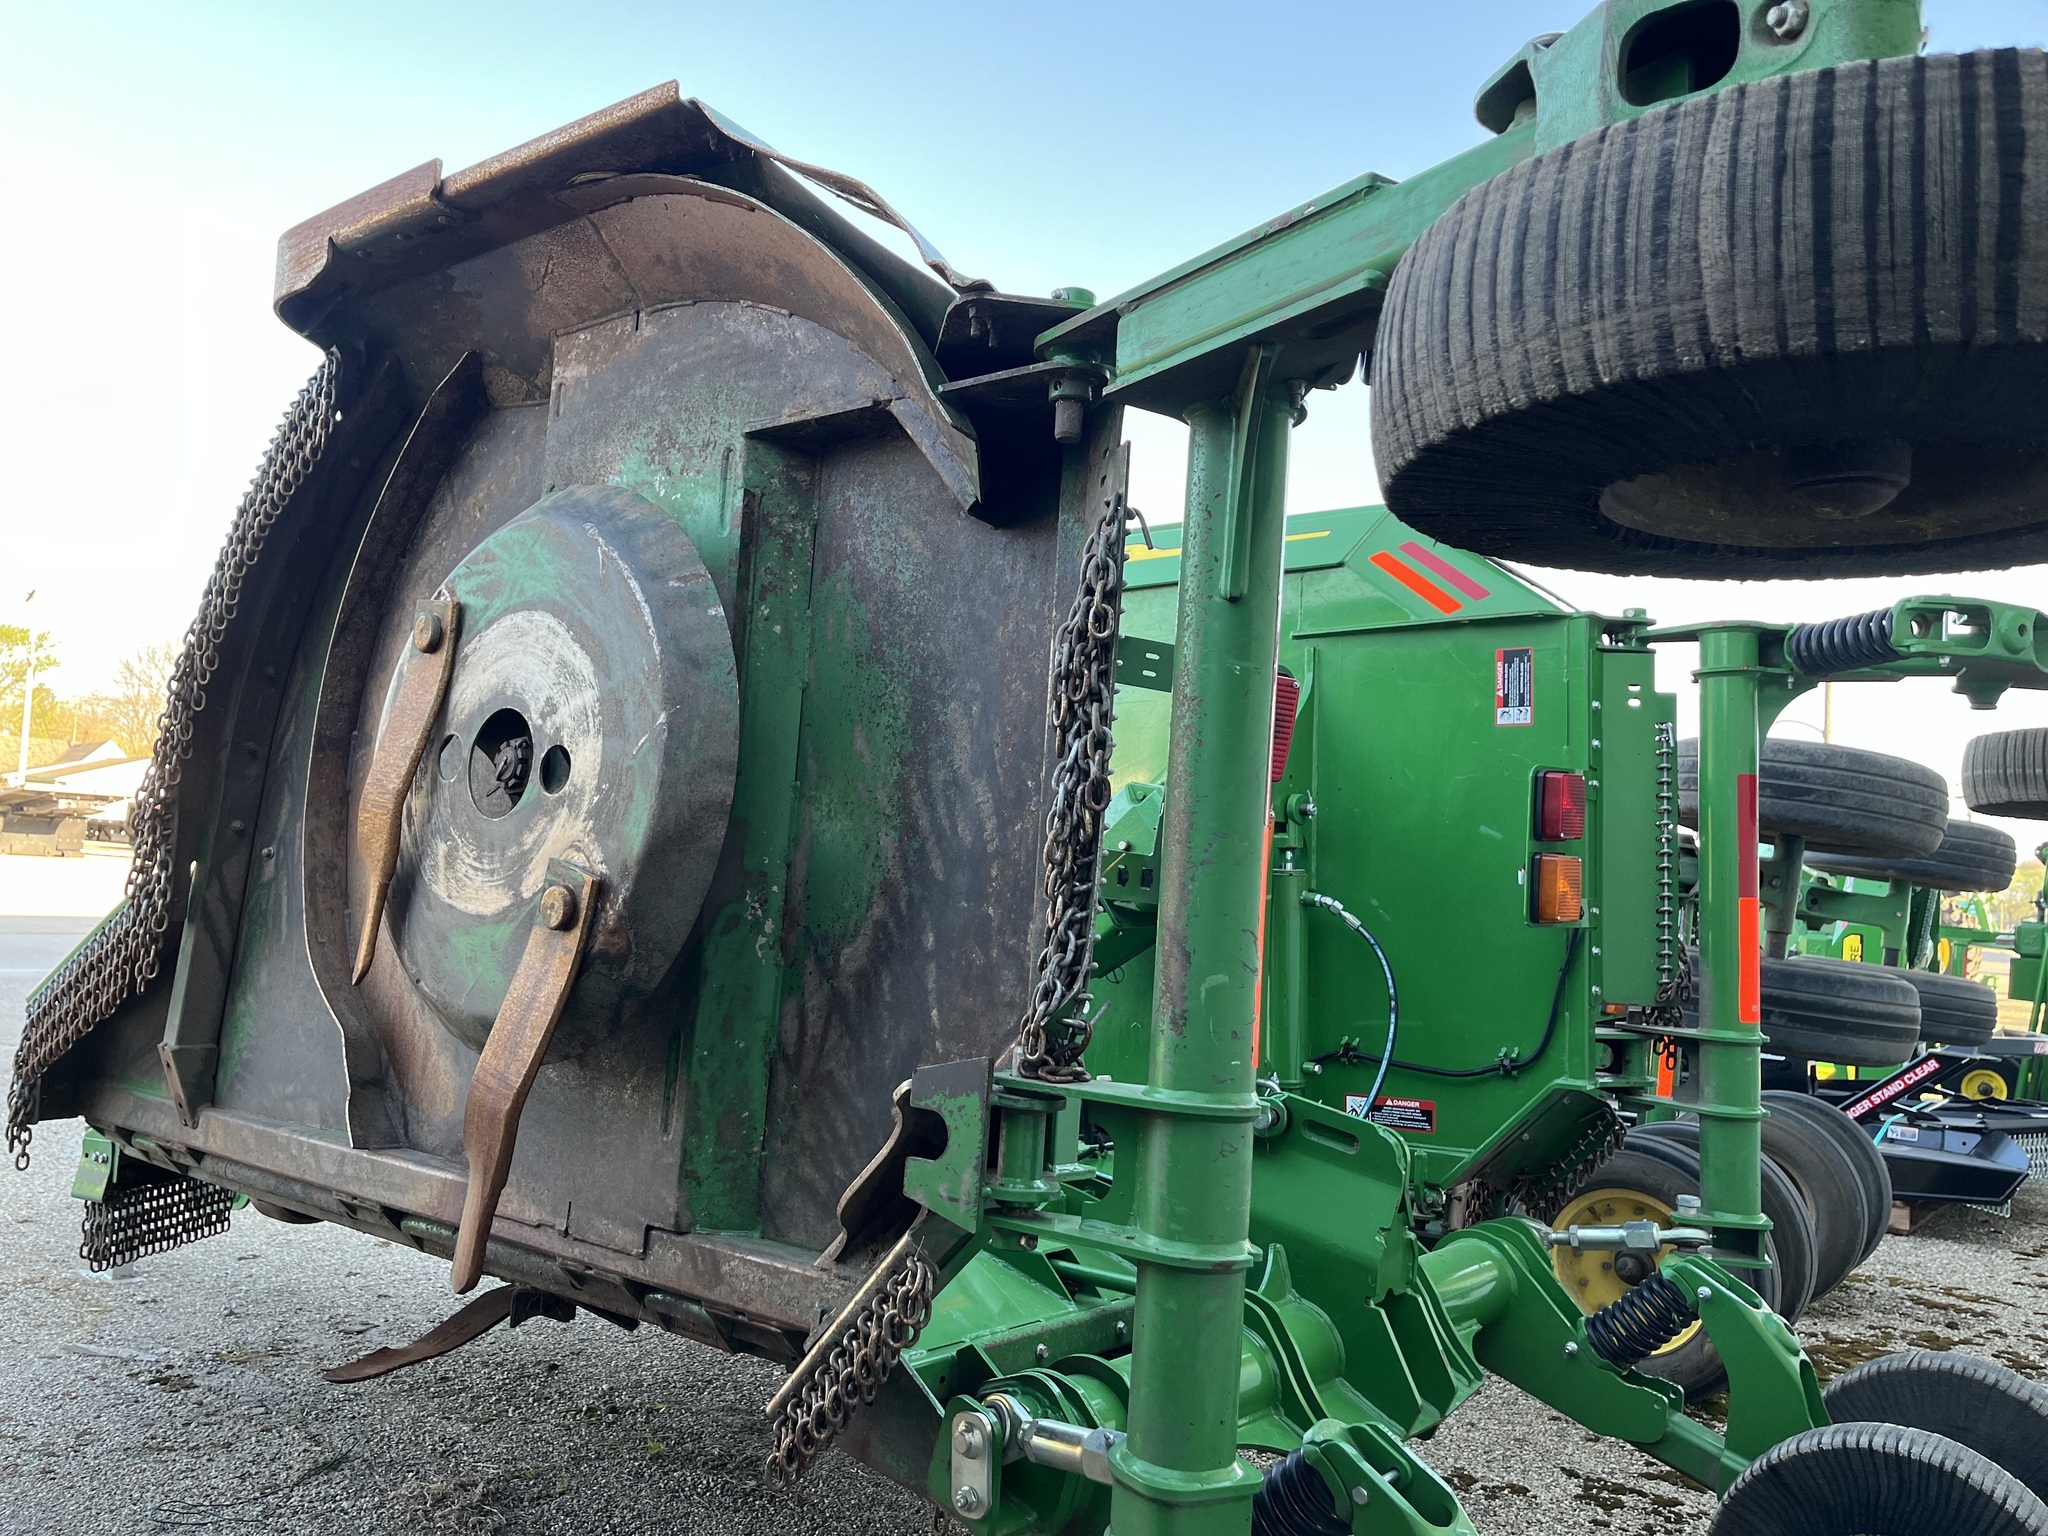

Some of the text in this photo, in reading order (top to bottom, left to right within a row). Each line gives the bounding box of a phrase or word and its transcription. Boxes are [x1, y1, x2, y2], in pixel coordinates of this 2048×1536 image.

[1496, 661, 1504, 689] DANGER
[1870, 1080, 1905, 1105] STAND
[1903, 1058, 1940, 1085] CLEAR
[1392, 1099, 1420, 1108] DANGER
